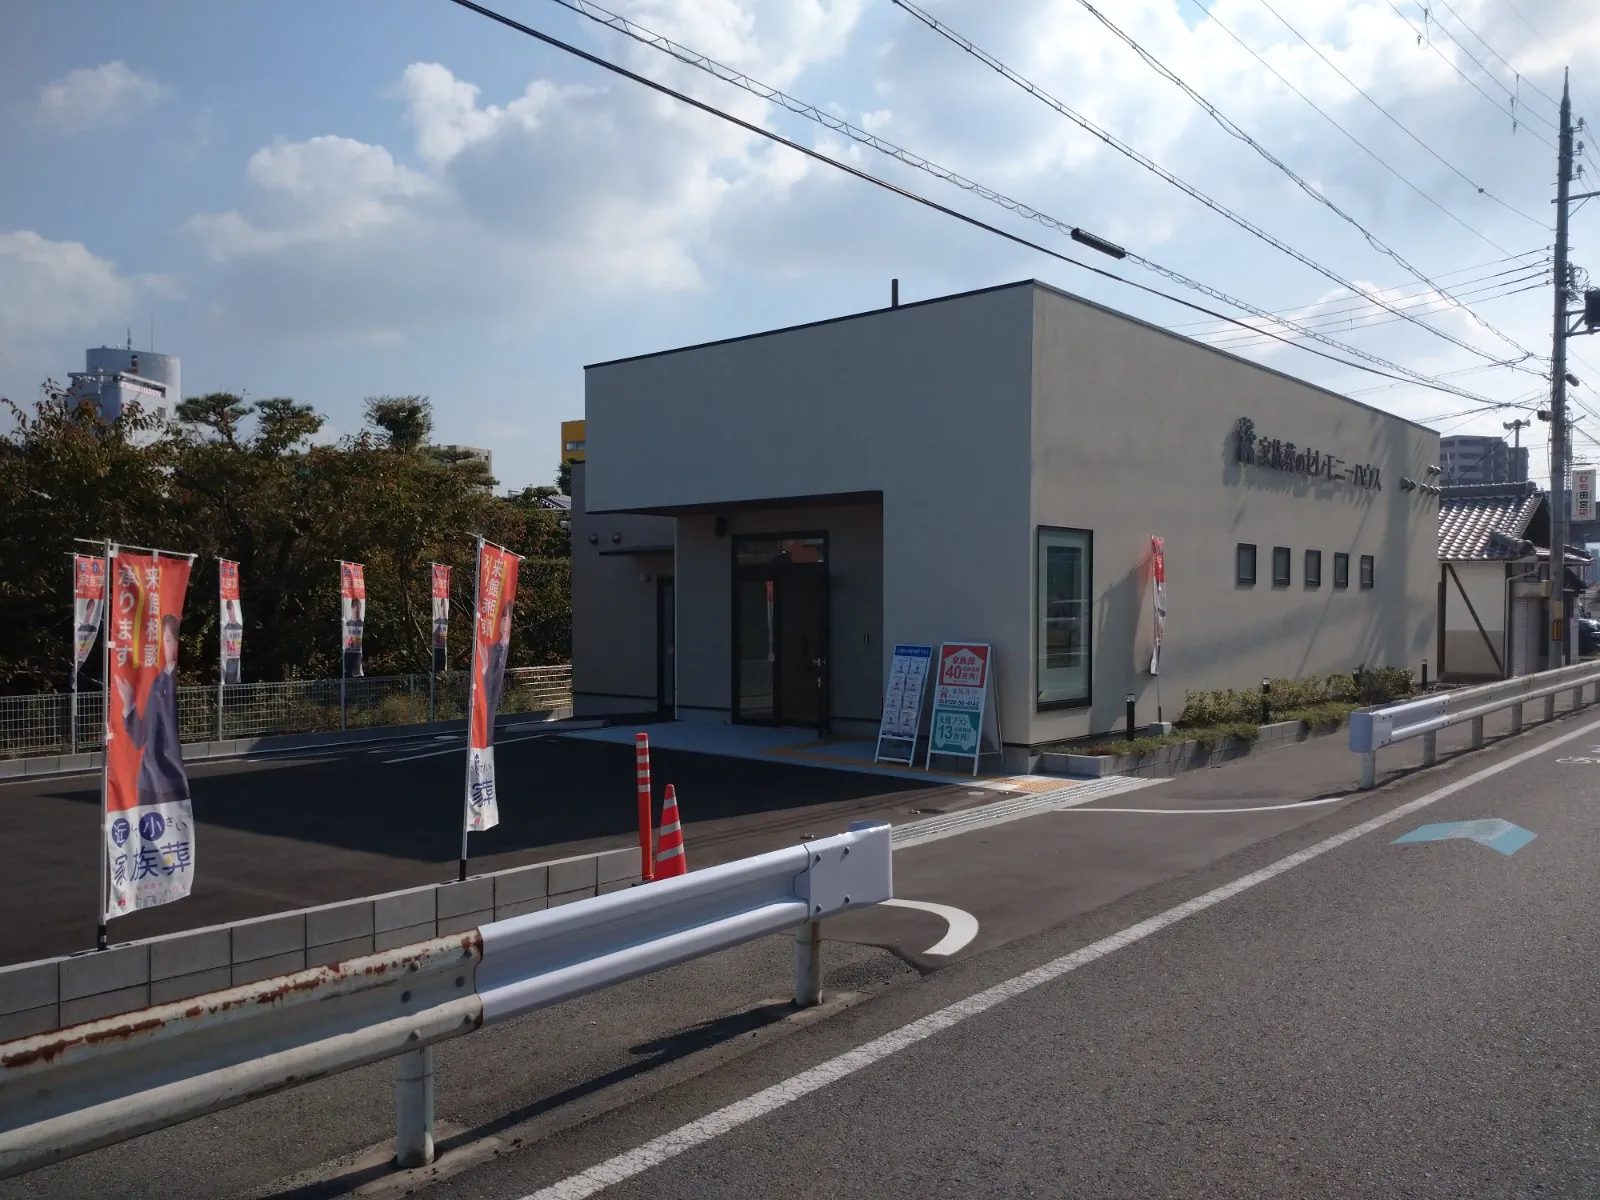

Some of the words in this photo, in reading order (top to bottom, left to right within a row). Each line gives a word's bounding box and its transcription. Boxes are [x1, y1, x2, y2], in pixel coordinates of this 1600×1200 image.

[116, 563, 139, 668] 承ります
[144, 566, 160, 668] 来館相談
[114, 841, 191, 886] 家族葬
